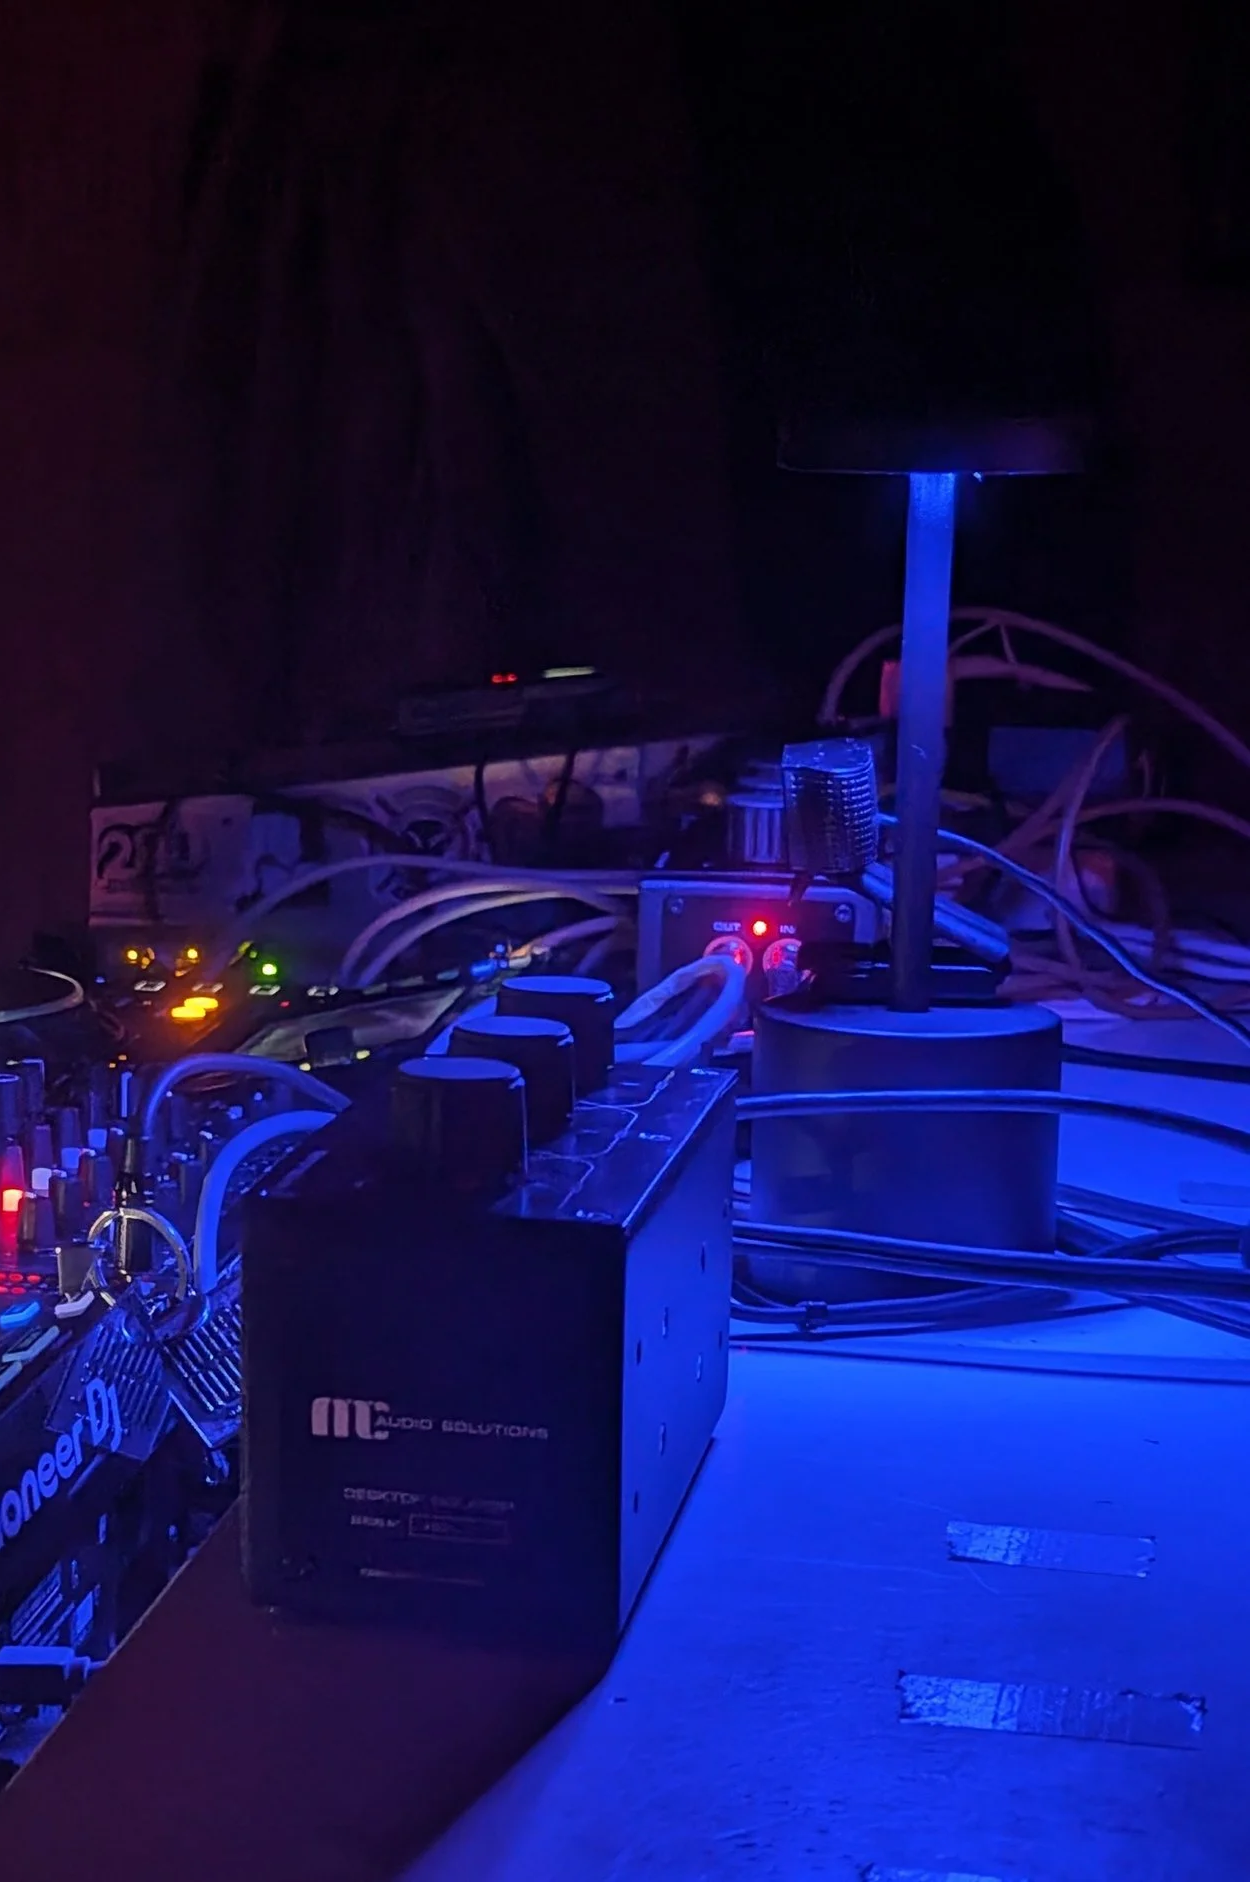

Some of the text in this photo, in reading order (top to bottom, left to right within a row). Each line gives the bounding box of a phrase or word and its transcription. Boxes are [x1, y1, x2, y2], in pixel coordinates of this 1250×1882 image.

[712, 921, 742, 932] OUT
[779, 924, 796, 934] IN
[86, 1377, 122, 1452] DJ
[374, 1414, 549, 1440] AUDIO SOLUTIONS
